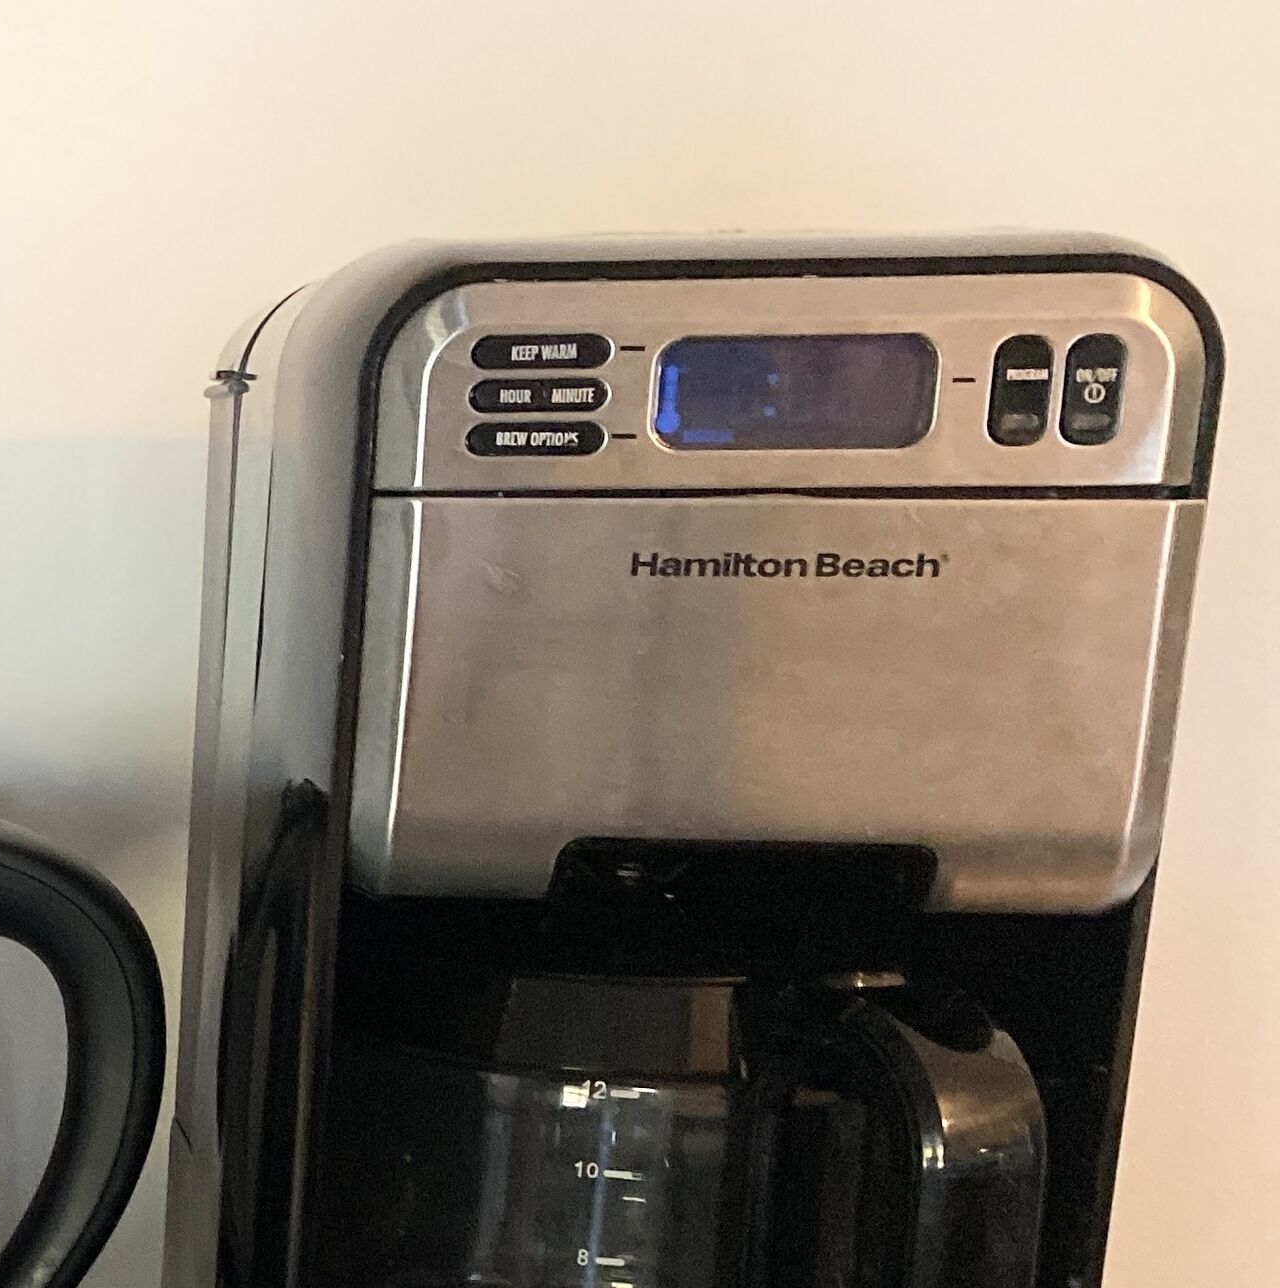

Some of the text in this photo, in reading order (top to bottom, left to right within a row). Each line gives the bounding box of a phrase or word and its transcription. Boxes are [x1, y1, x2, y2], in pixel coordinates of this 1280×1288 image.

[511, 343, 578, 361] KEEP WARM
[500, 388, 595, 403] HOUR MINUTE
[496, 431, 529, 446] BREW
[630, 551, 940, 578] Hamilton Beach
[582, 1080, 607, 1099] 12
[574, 1160, 600, 1179] 10
[577, 1249, 589, 1266] 8
